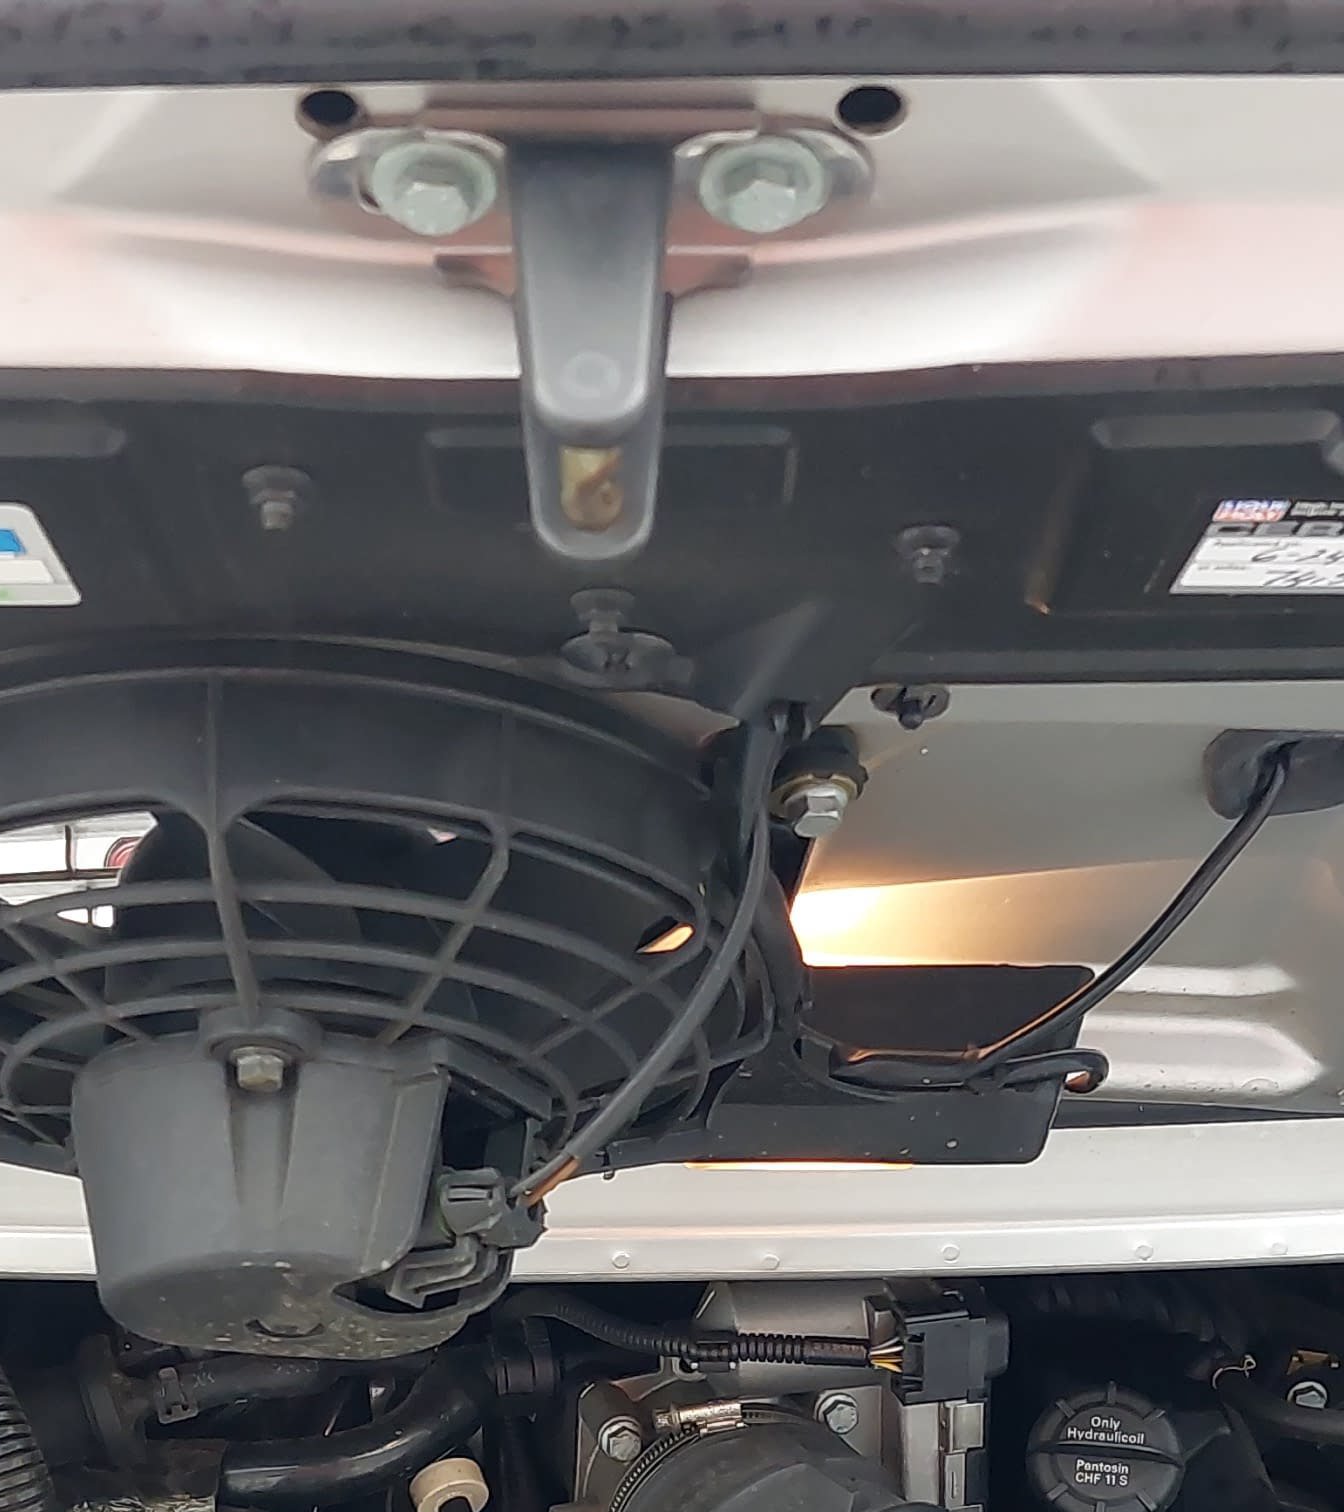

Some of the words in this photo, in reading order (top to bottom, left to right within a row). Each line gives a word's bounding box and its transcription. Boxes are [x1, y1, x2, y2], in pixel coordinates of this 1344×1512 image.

[1090, 1416, 1121, 1431] Only
[1066, 1427, 1145, 1445] Hydraulicoil
[1074, 1472, 1102, 1486] CHF
[1104, 1474, 1117, 1486] 11
[1119, 1475, 1130, 1487] S
